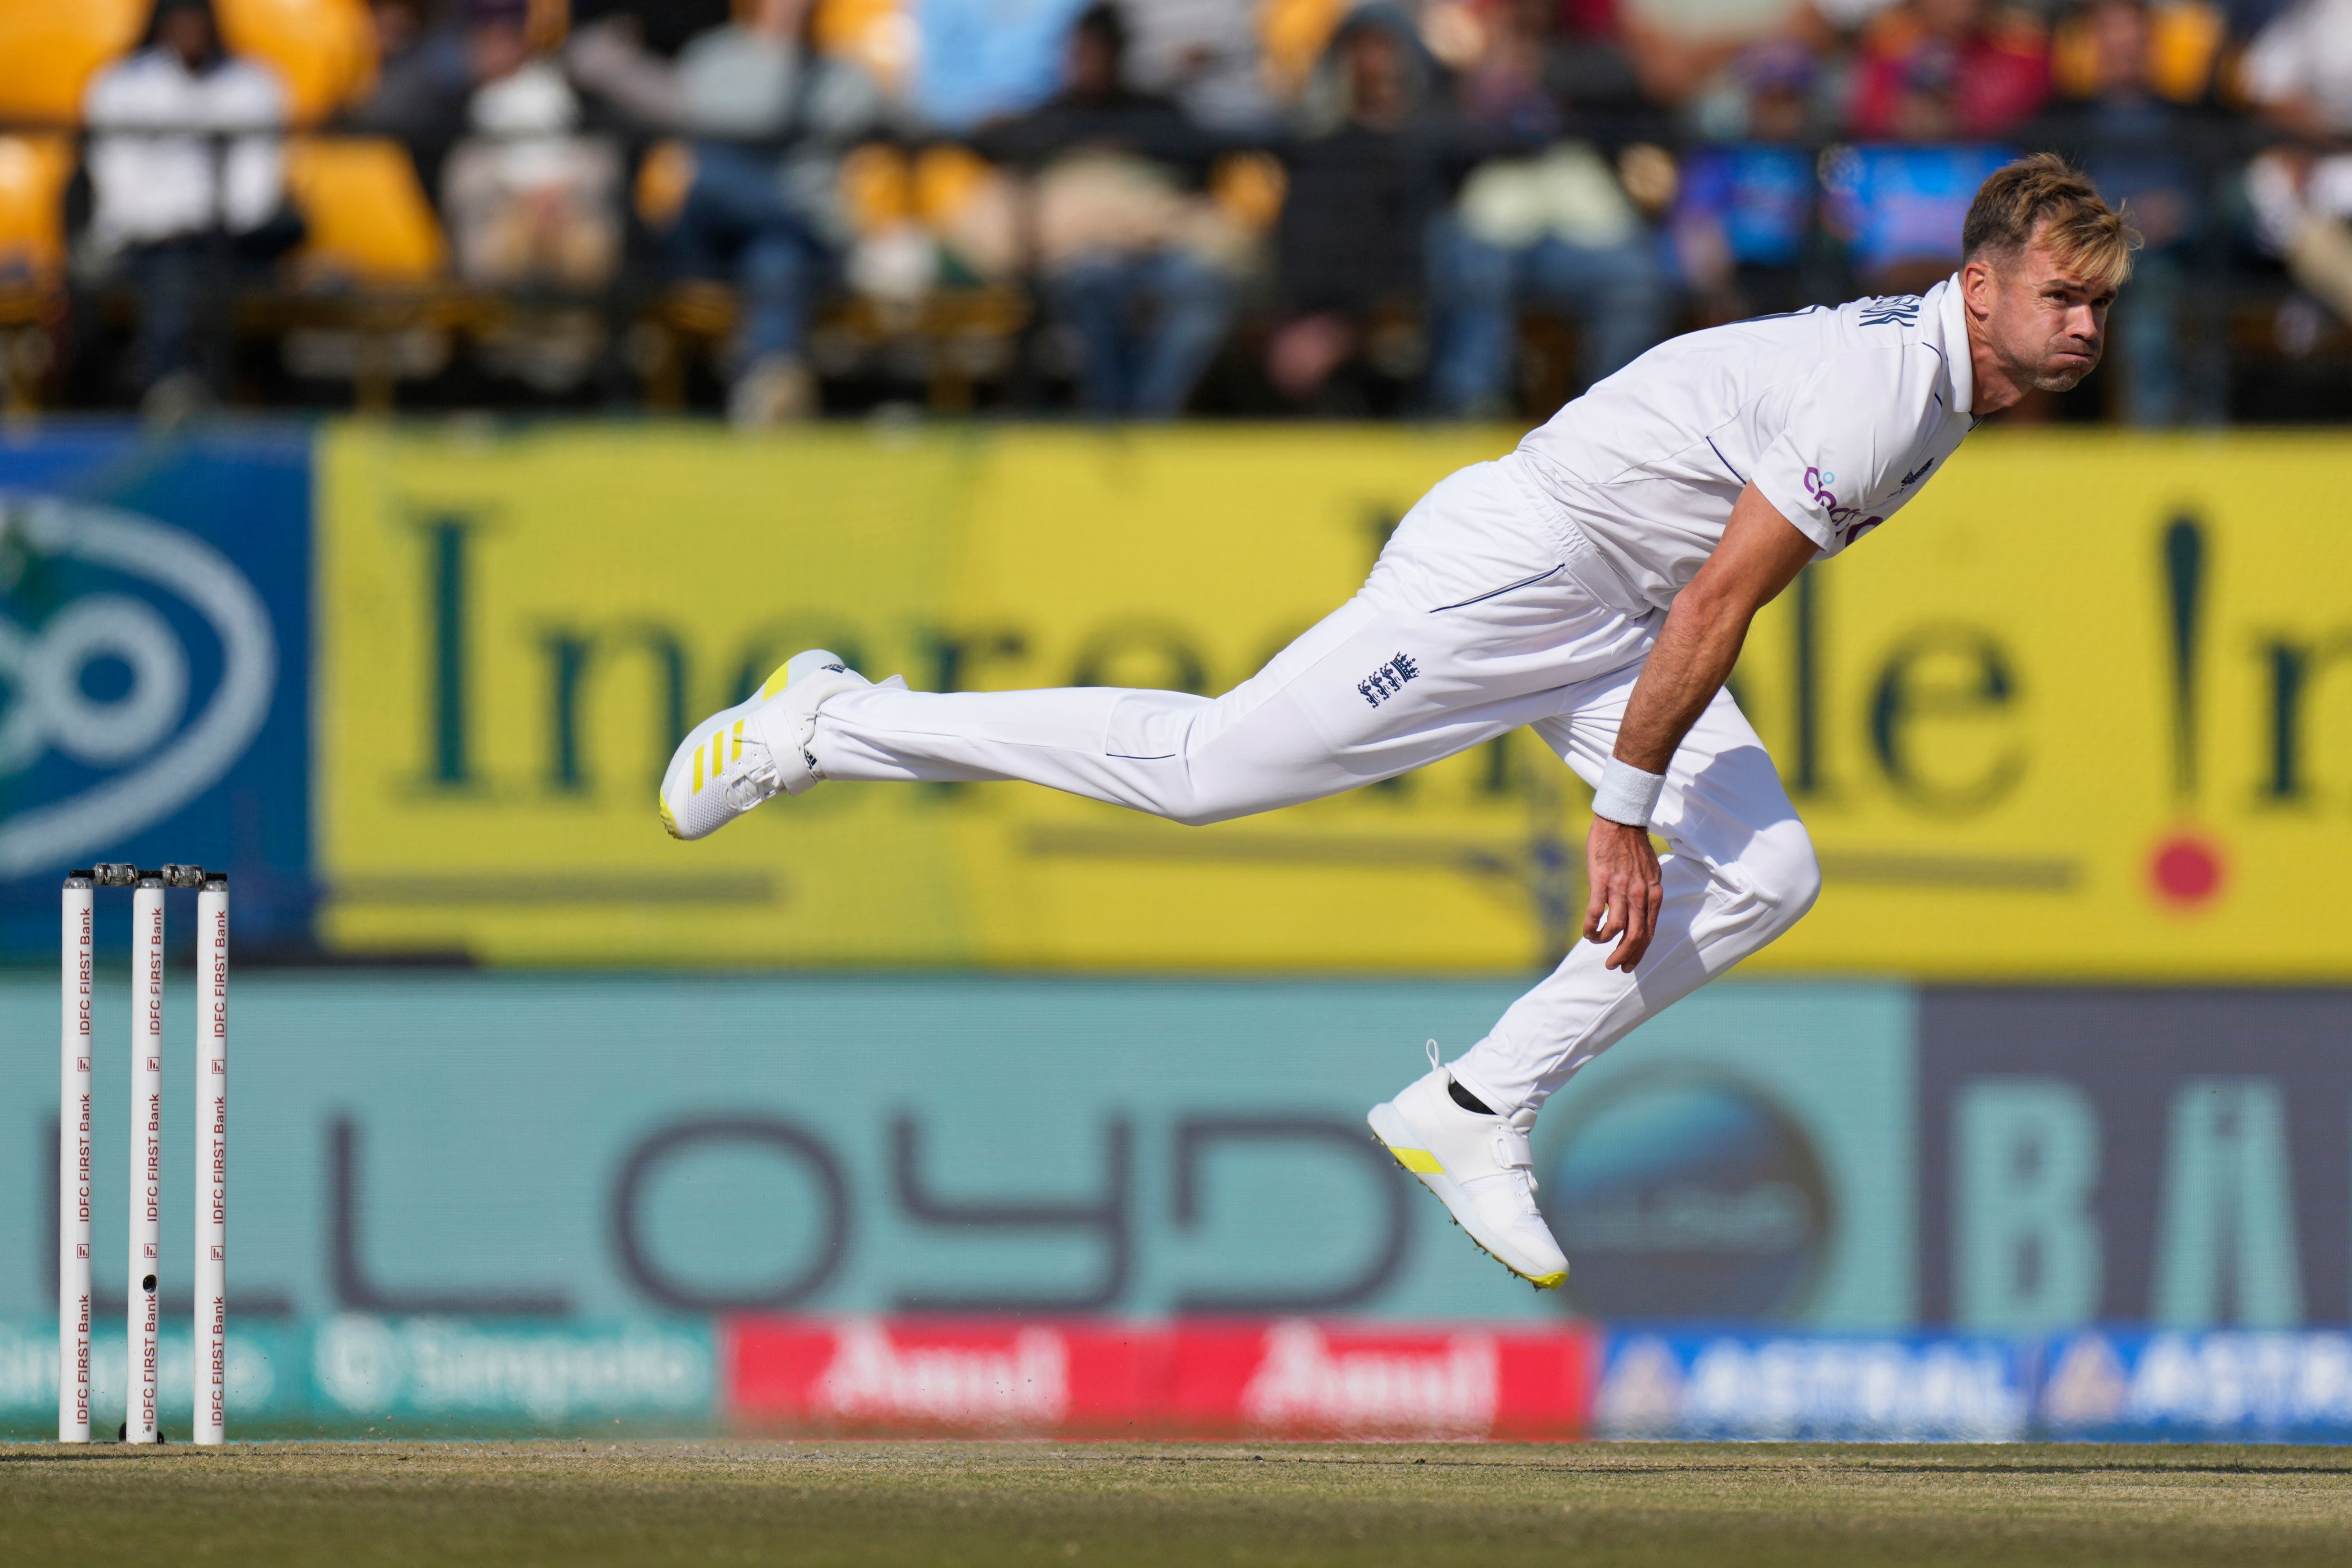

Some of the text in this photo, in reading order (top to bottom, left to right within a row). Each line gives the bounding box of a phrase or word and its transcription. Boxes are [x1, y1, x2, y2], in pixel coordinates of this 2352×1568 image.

[79, 908, 90, 1035] IDFC FIRST Bank
[150, 908, 161, 1035] IDFC FIRST Bank
[214, 911, 225, 1038] IDFC FIRST Bank
[79, 1095, 89, 1222] IDFC FIRST Bank
[147, 1094, 158, 1221] IDFC FIRST Bank
[213, 1097, 223, 1224] IDFC FIRST Bank
[77, 1295, 88, 1424] IDFC FIRST Bank
[143, 1295, 155, 1424] IDFC FIRST Bank
[212, 1296, 222, 1426] IDFC FIRST Bank
